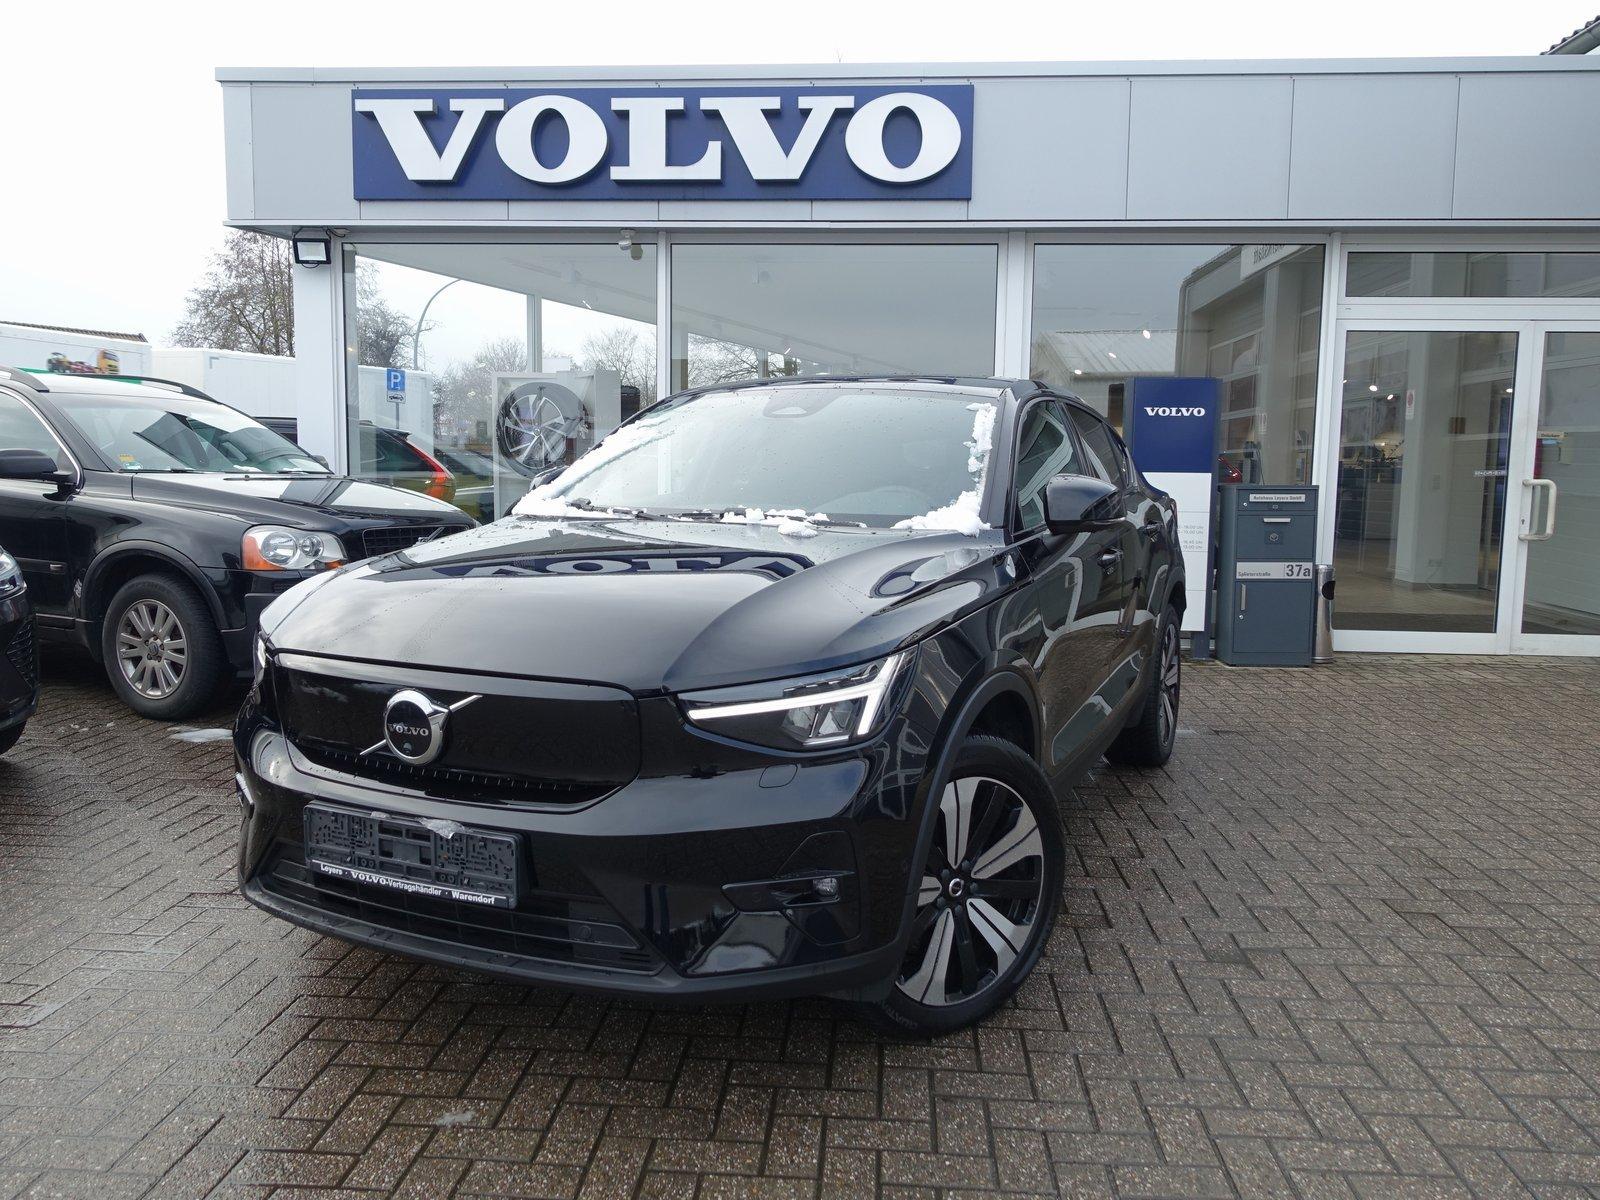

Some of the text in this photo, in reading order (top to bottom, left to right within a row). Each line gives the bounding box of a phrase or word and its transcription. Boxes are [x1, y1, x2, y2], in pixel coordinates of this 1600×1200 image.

[354, 91, 962, 184] VOLVO
[391, 371, 401, 389] P
[1143, 406, 1206, 417] VOLVO
[1285, 564, 1311, 577] 37a
[387, 722, 429, 737] VOLVO
[320, 862, 343, 875] Leyers
[451, 890, 495, 904] Warendorf
